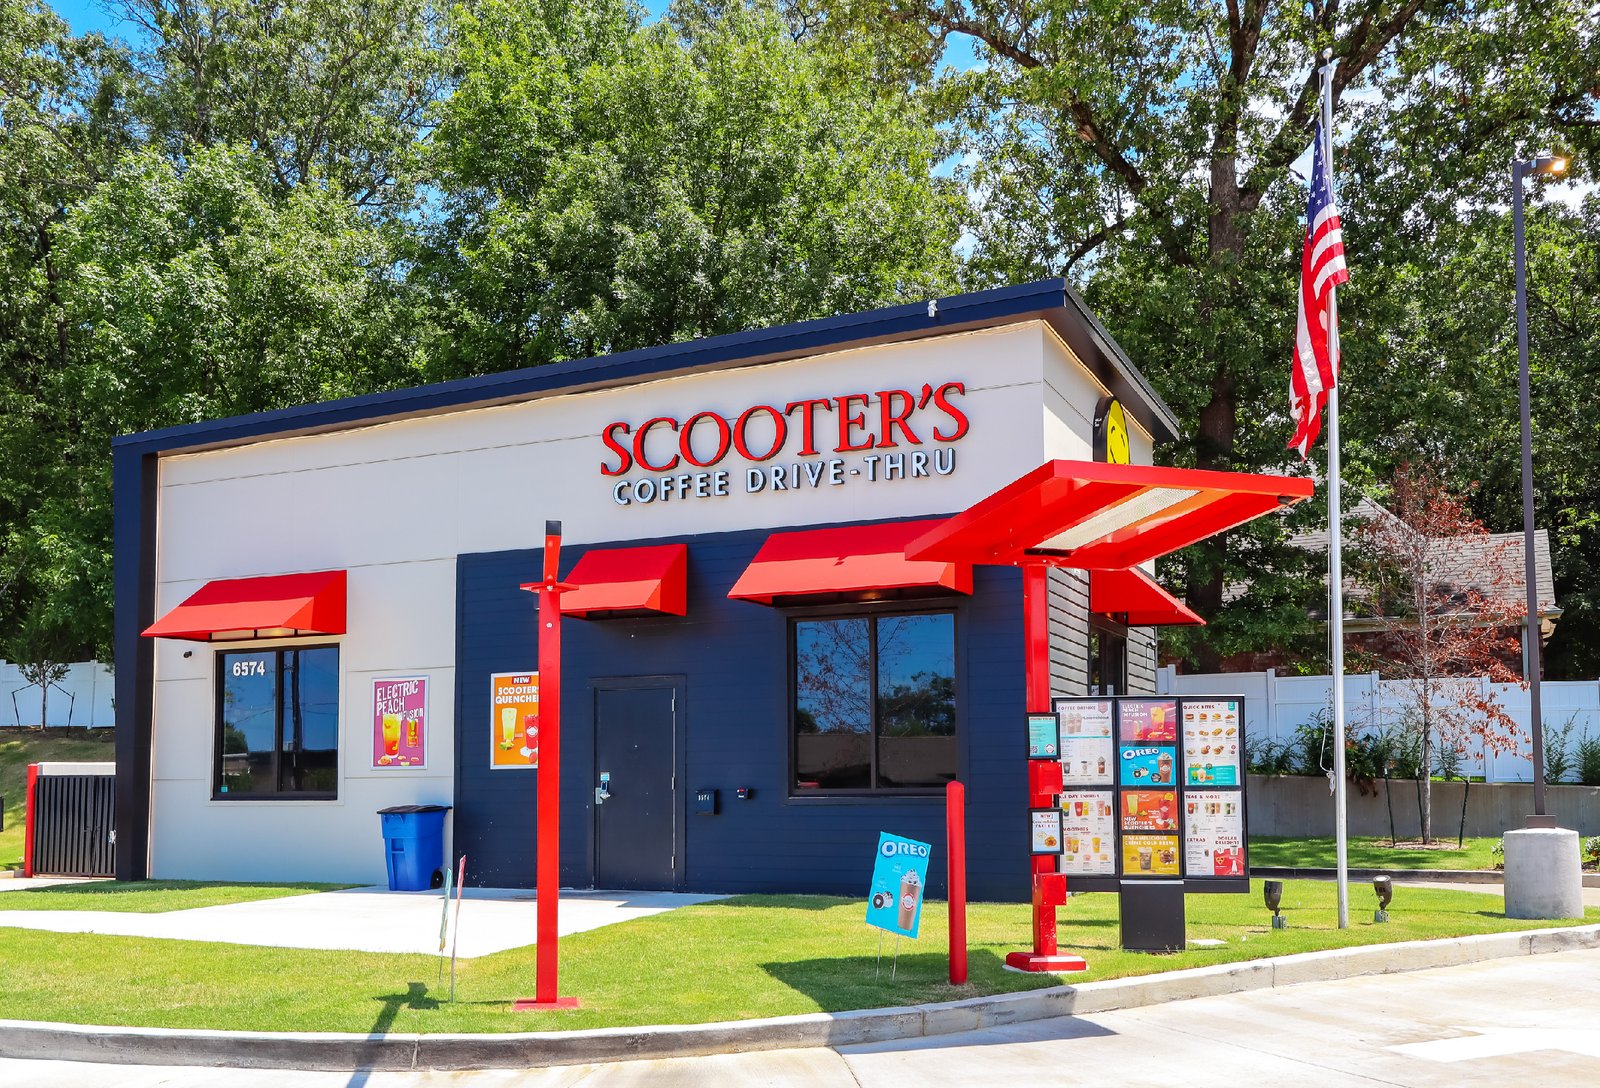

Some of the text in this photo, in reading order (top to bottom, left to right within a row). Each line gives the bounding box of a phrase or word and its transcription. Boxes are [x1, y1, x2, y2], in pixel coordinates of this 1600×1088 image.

[601, 382, 970, 476] SCOOTER'S
[613, 448, 956, 505] COFFEE DRIVE-THRU
[233, 661, 265, 676] 6574
[376, 680, 419, 702] ELECTRIC
[495, 694, 539, 704] QUENCHE
[376, 697, 405, 717] PEACH
[1122, 748, 1160, 760] OREO
[881, 841, 928, 858] OREO
